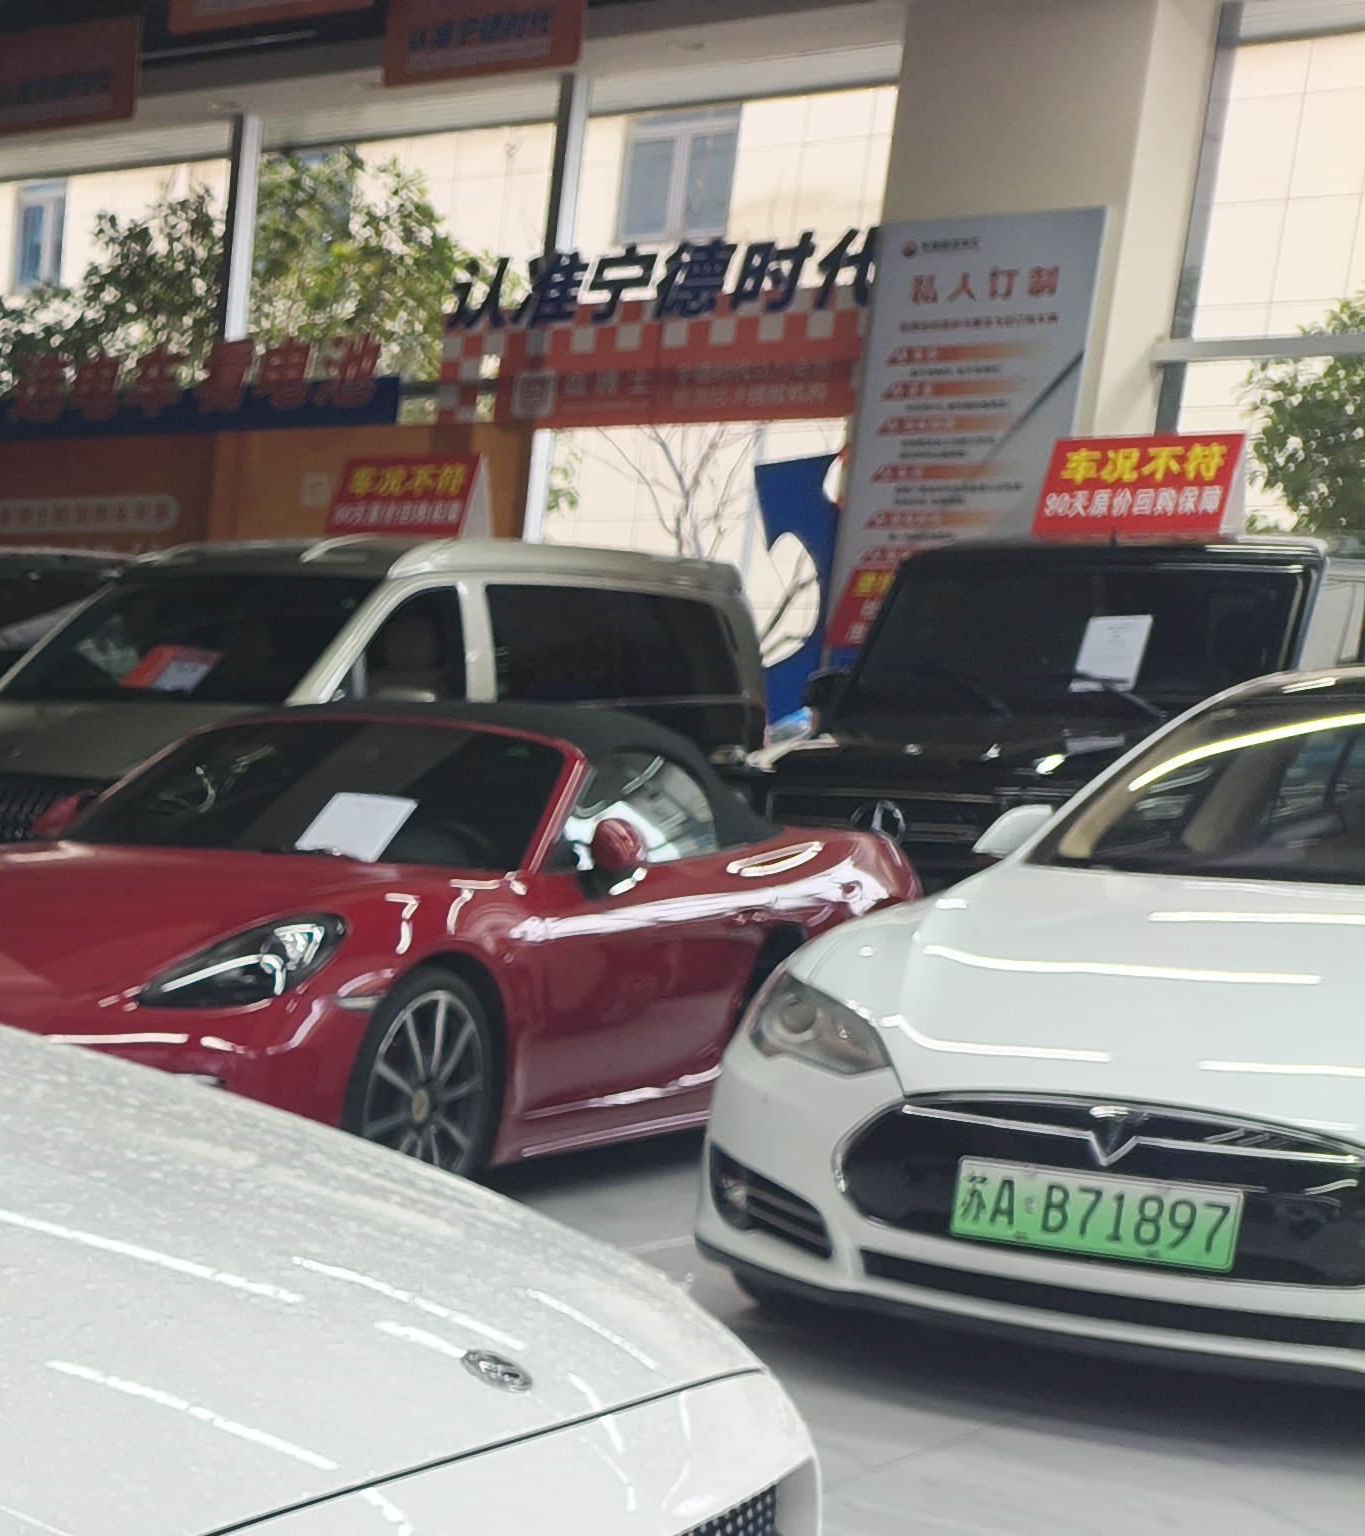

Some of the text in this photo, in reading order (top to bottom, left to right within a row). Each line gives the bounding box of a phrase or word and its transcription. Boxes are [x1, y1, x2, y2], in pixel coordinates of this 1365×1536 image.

[448, 226, 881, 328] 认准宁德时代
[910, 264, 1072, 305] 私人订制
[348, 462, 467, 498] 车况不符
[1060, 442, 1228, 486] 车况不符
[1043, 485, 1223, 518] 90天原价回购保障
[1041, 1184, 1231, 1253] B71897
